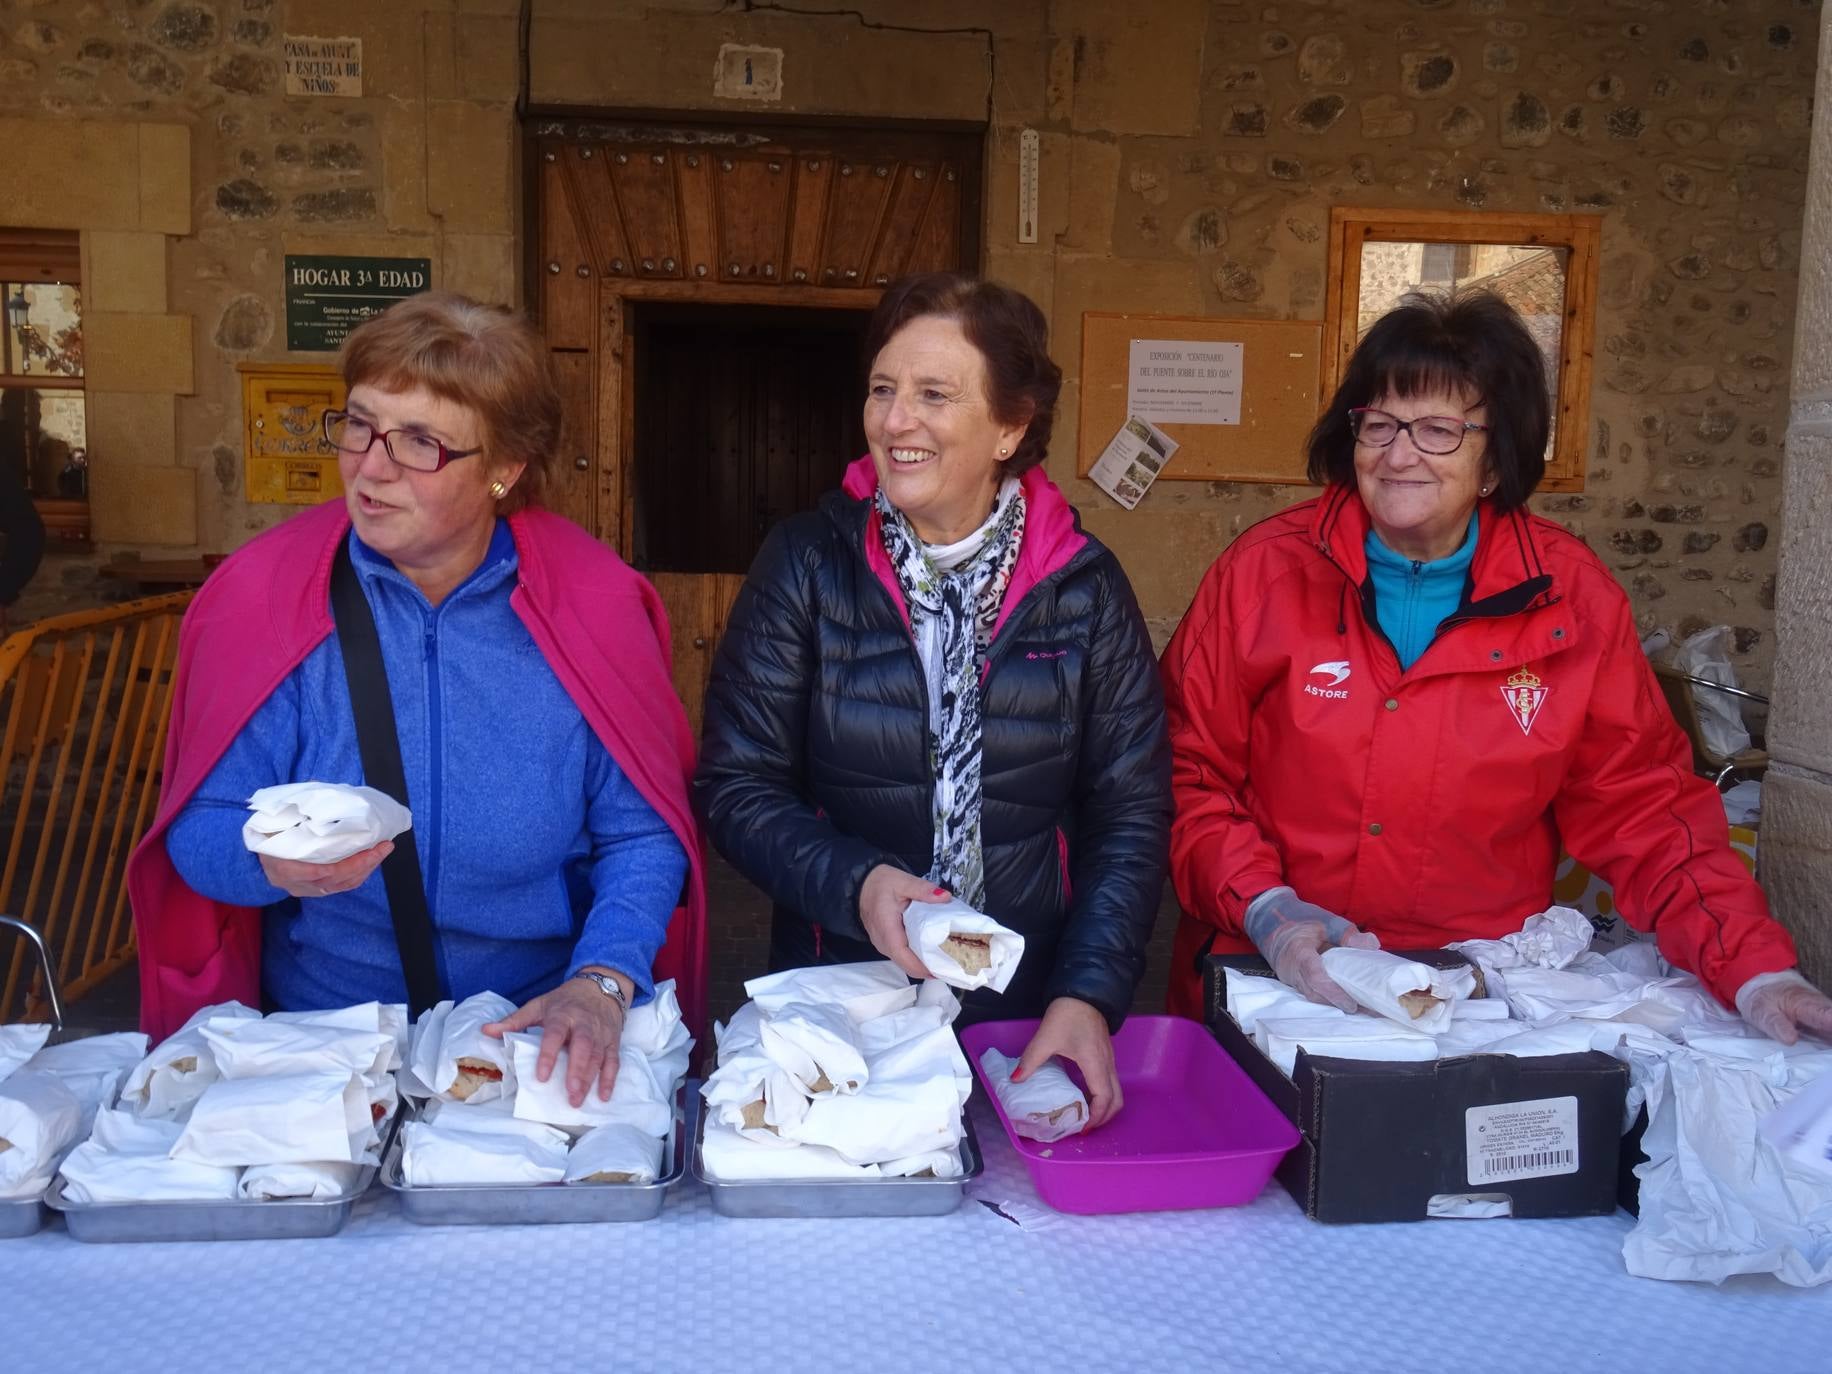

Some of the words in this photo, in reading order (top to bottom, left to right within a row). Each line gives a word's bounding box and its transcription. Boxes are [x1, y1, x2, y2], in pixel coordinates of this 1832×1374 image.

[284, 42, 310, 57] CASA
[284, 60, 291, 74] Y
[296, 60, 342, 77] ESCUELA
[346, 62, 360, 77] DE
[744, 56, 753, 86] 1
[301, 75, 336, 93] NIÑOS
[293, 268, 350, 286] HOGAR
[379, 271, 424, 288] EDAD
[322, 306, 350, 315] Gobierno
[351, 307, 359, 315] de
[370, 308, 378, 316] La
[1149, 350, 1182, 361] EXPOSICIÓN
[1140, 367, 1151, 377] DEL
[1153, 367, 1175, 377] PUENTE
[1177, 367, 1195, 378] SOBRE
[1197, 368, 1205, 378] EL
[1304, 684, 1349, 699] ASTORE
